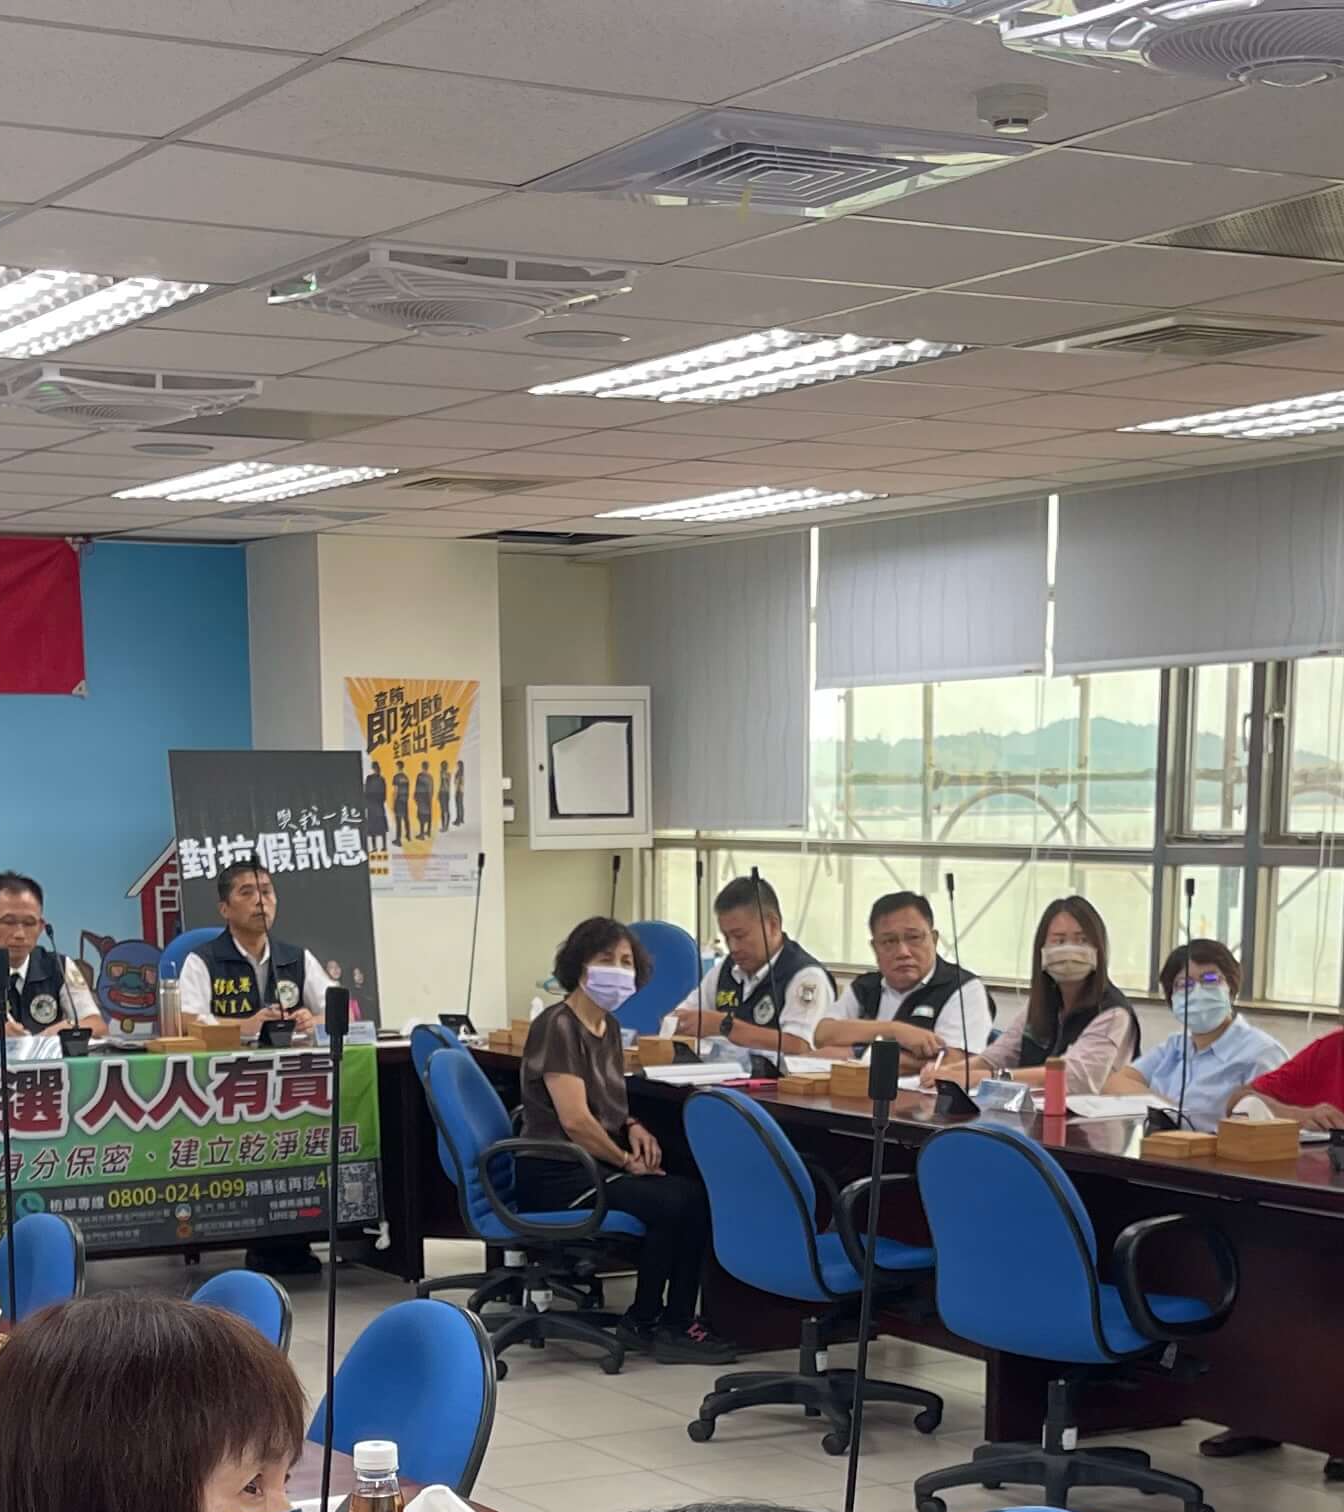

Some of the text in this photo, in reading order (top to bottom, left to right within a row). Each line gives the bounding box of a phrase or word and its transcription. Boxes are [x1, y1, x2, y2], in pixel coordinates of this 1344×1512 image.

[178, 825, 368, 880] 對抗假訊息
[215, 998, 253, 1015] NIA
[78, 1053, 334, 1132] 人人有責
